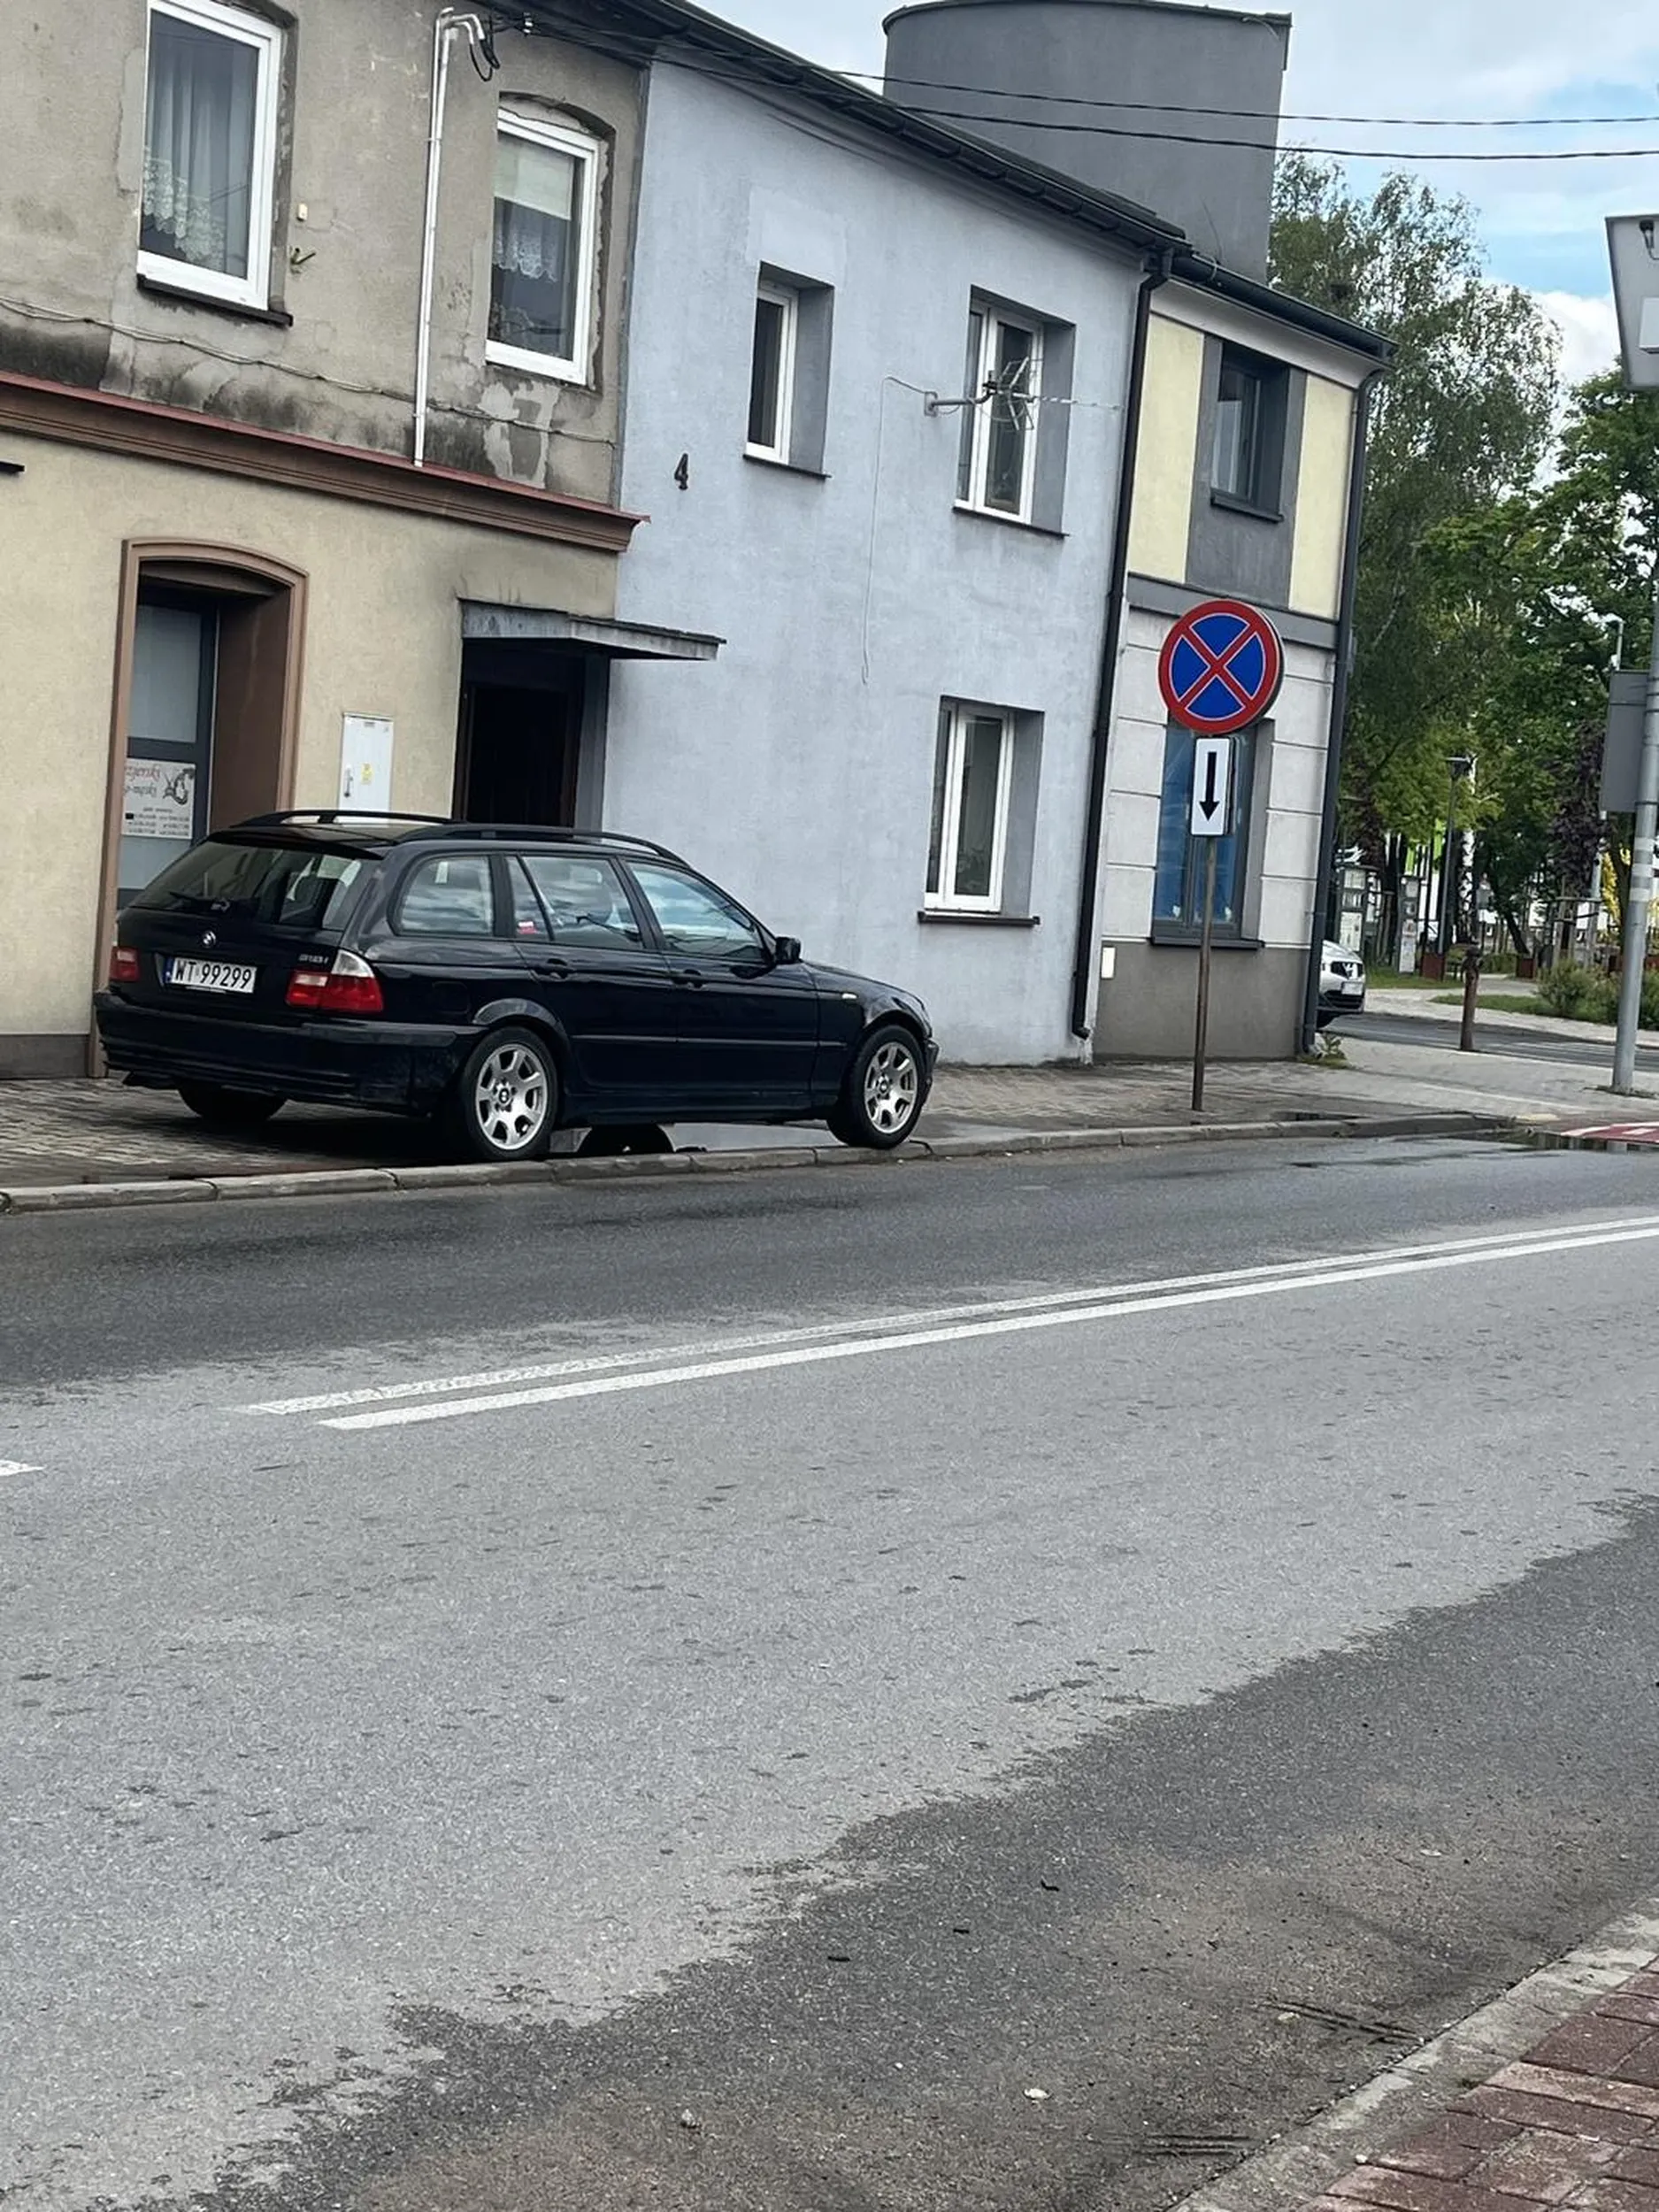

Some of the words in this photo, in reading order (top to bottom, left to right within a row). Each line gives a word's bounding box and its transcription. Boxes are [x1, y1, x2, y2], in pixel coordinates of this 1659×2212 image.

[674, 452, 688, 490] 4
[175, 959, 196, 982] WT
[200, 963, 252, 989] 99299
